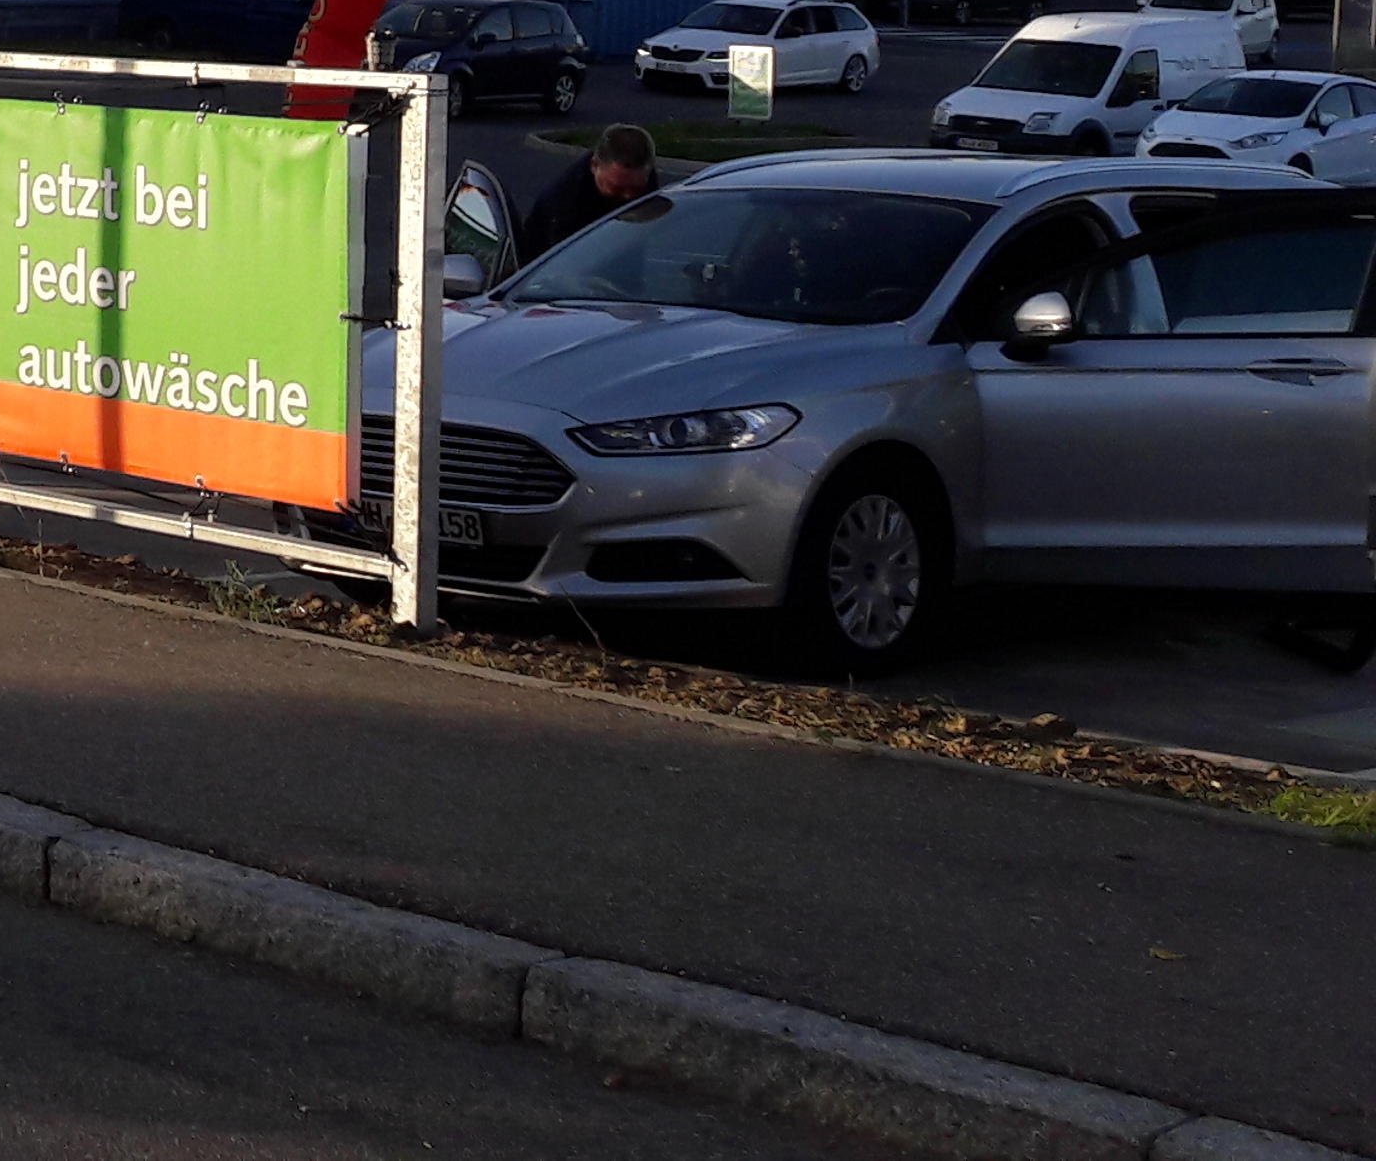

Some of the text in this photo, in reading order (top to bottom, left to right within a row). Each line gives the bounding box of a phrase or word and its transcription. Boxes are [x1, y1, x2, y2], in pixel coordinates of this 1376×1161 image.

[15, 158, 210, 230] jetzt bei
[15, 244, 137, 314] jeder
[18, 340, 309, 427] autowäsche
